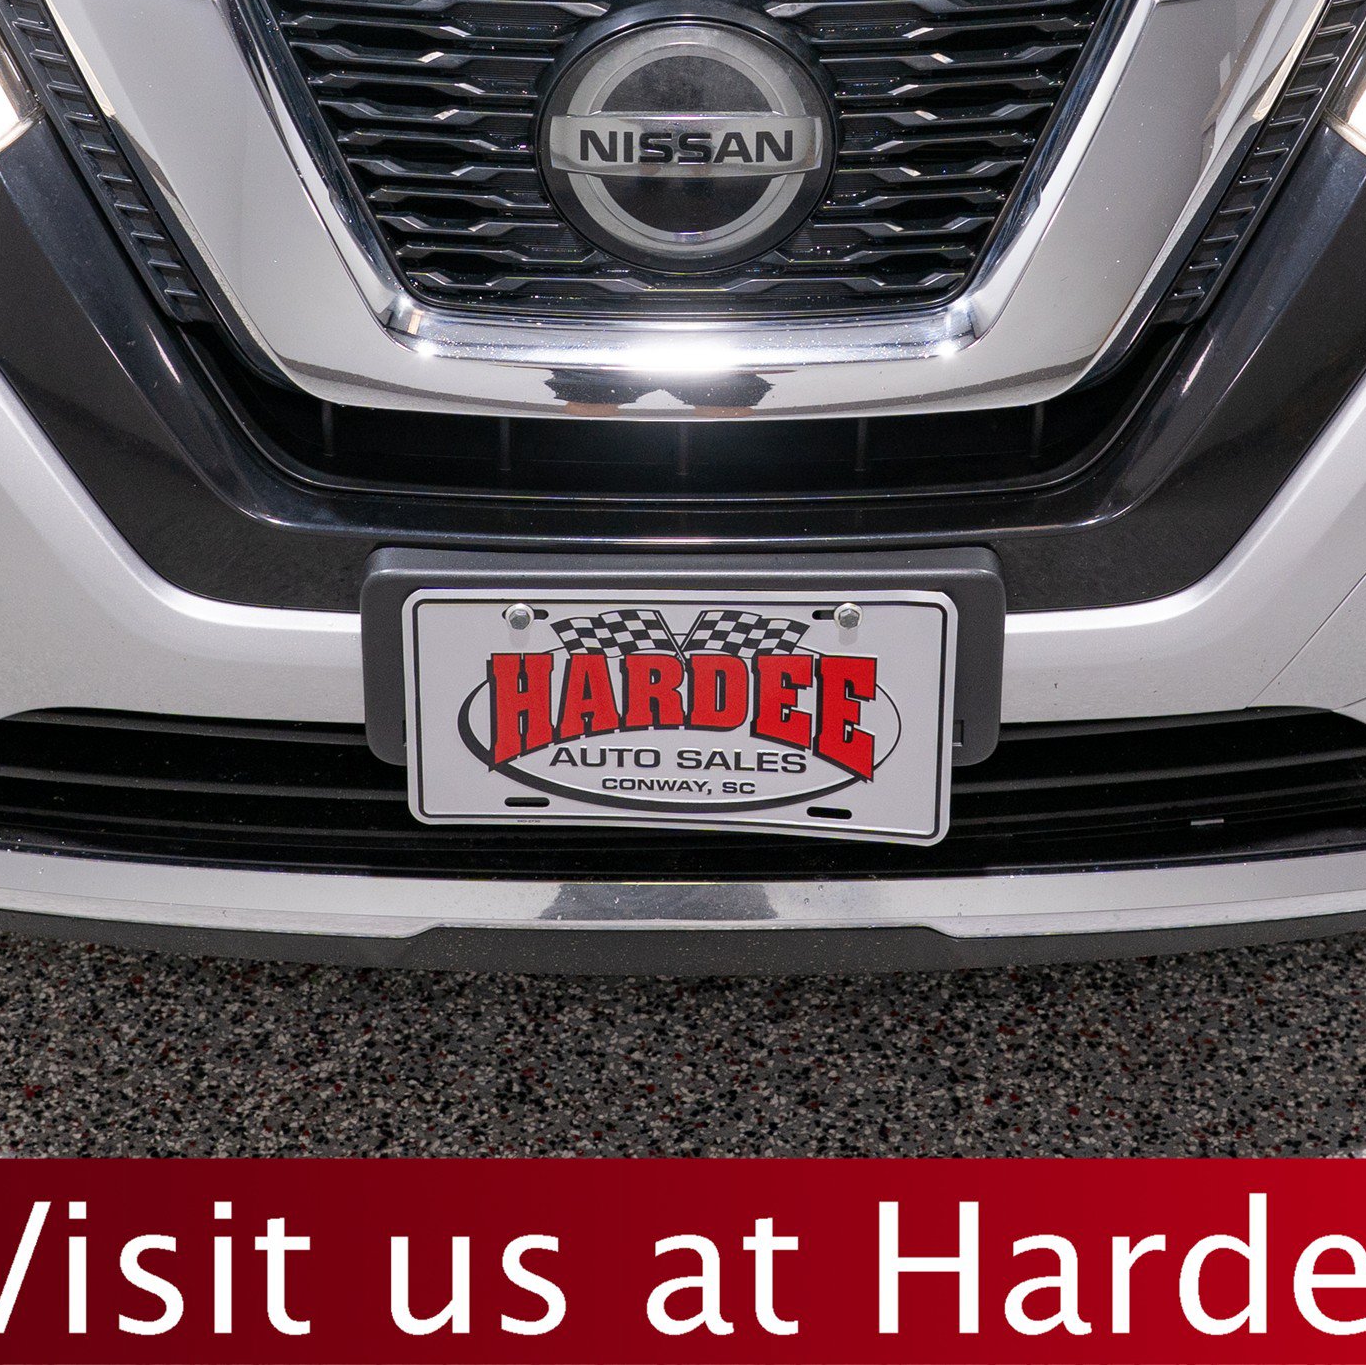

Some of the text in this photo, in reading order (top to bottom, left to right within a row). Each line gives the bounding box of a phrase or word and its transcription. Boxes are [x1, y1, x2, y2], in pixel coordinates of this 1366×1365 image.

[579, 129, 794, 164] NISSAN
[487, 651, 878, 782] HARDEE
[549, 746, 808, 774] AUTO SALES
[601, 777, 756, 796] CONWAY, SC
